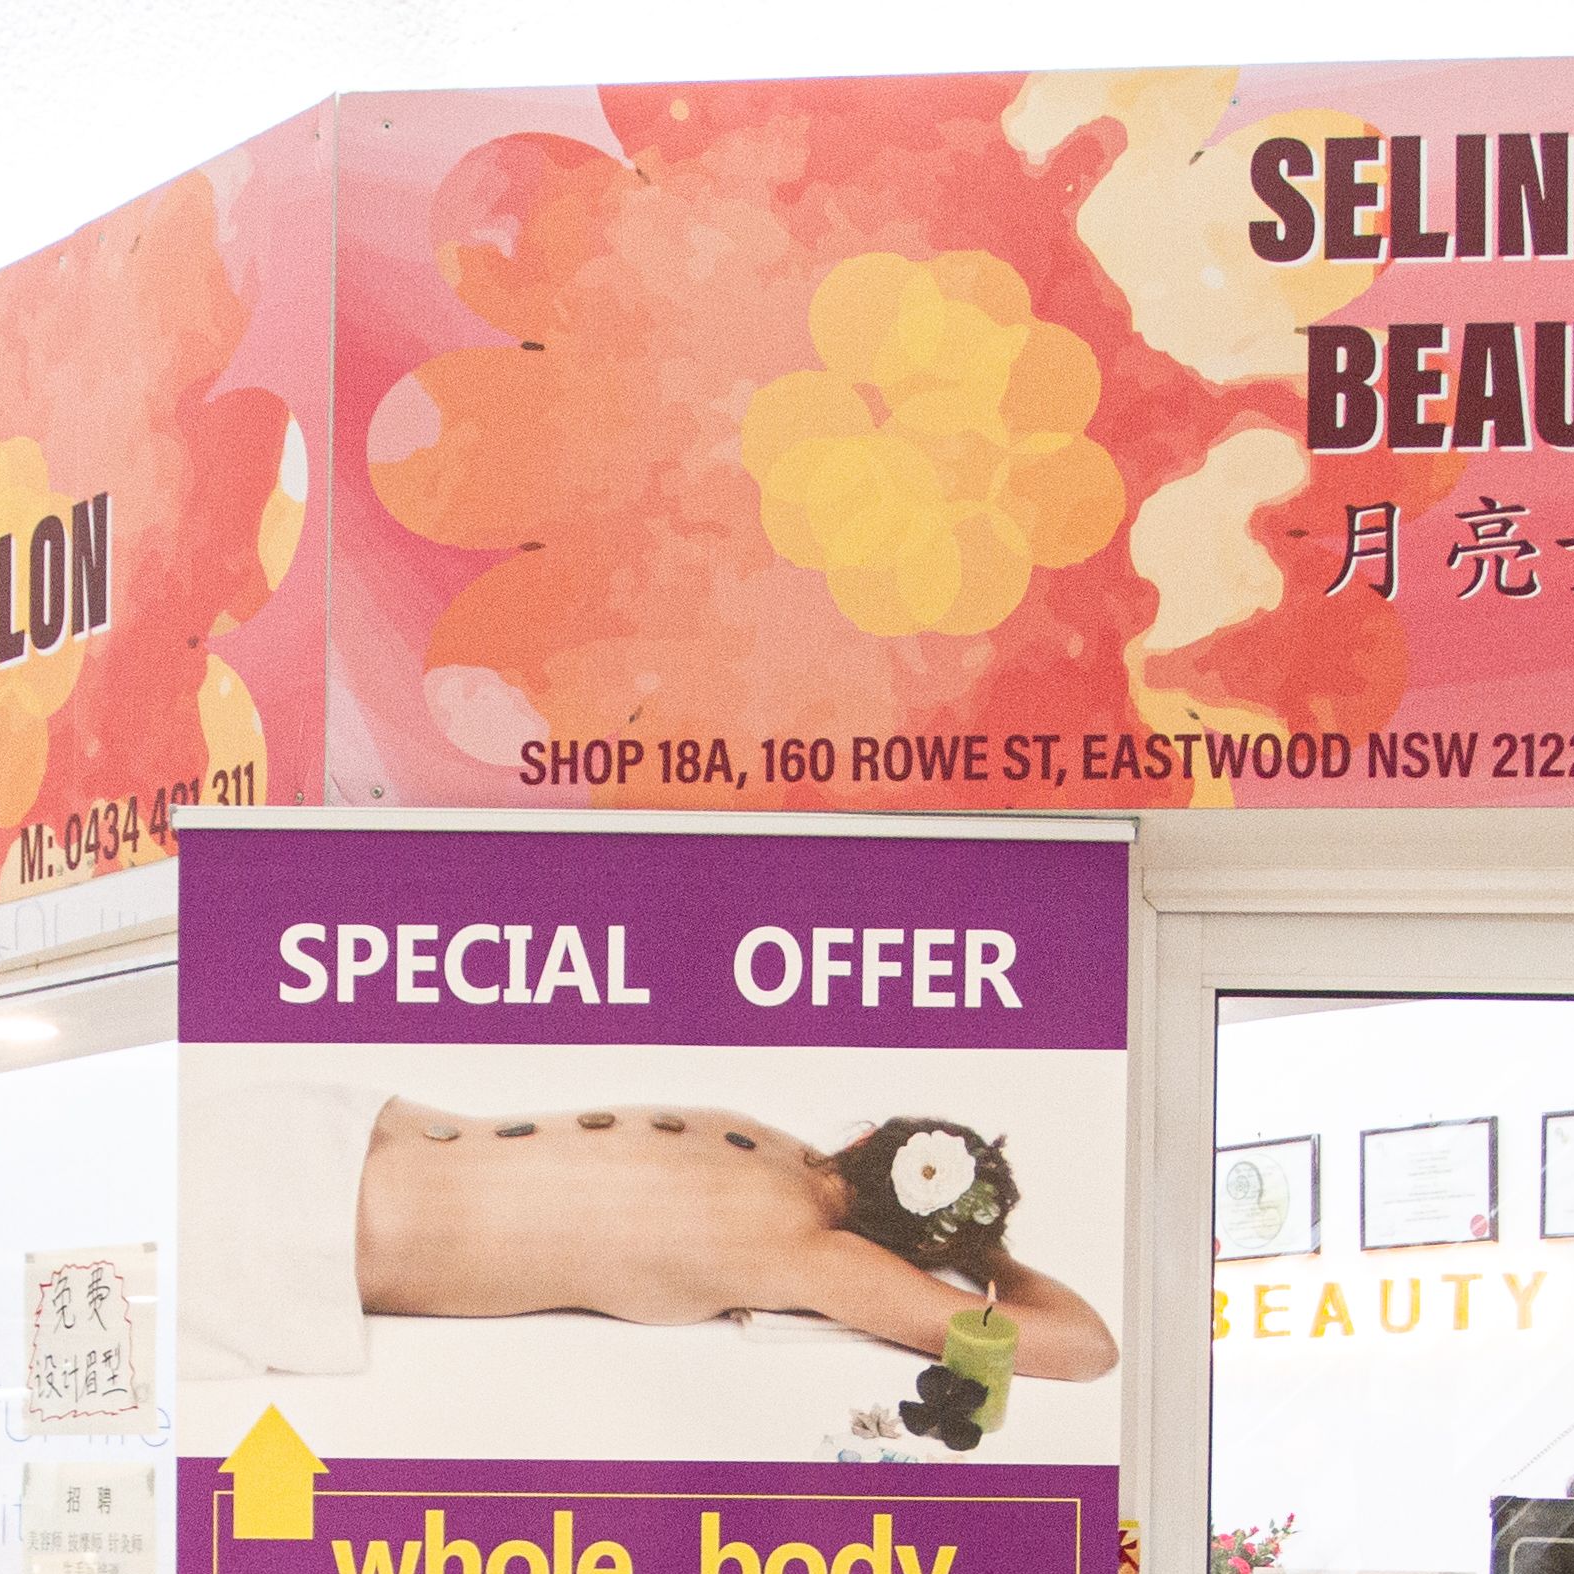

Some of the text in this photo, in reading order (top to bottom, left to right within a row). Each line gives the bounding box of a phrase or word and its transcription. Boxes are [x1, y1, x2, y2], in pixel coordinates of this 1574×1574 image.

[519, 738, 646, 786] SHOP
[659, 737, 748, 791] 18A,
[760, 736, 836, 784] 160
[851, 735, 990, 783] ROWE
[1003, 734, 1069, 789] ST,
[1082, 733, 1351, 781] EASTWOOD
[1368, 732, 1478, 780] NSW
[19, 826, 55, 885] M:
[64, 796, 139, 871] 0434
[278, 922, 1023, 1009] SPECIAL OFFER
